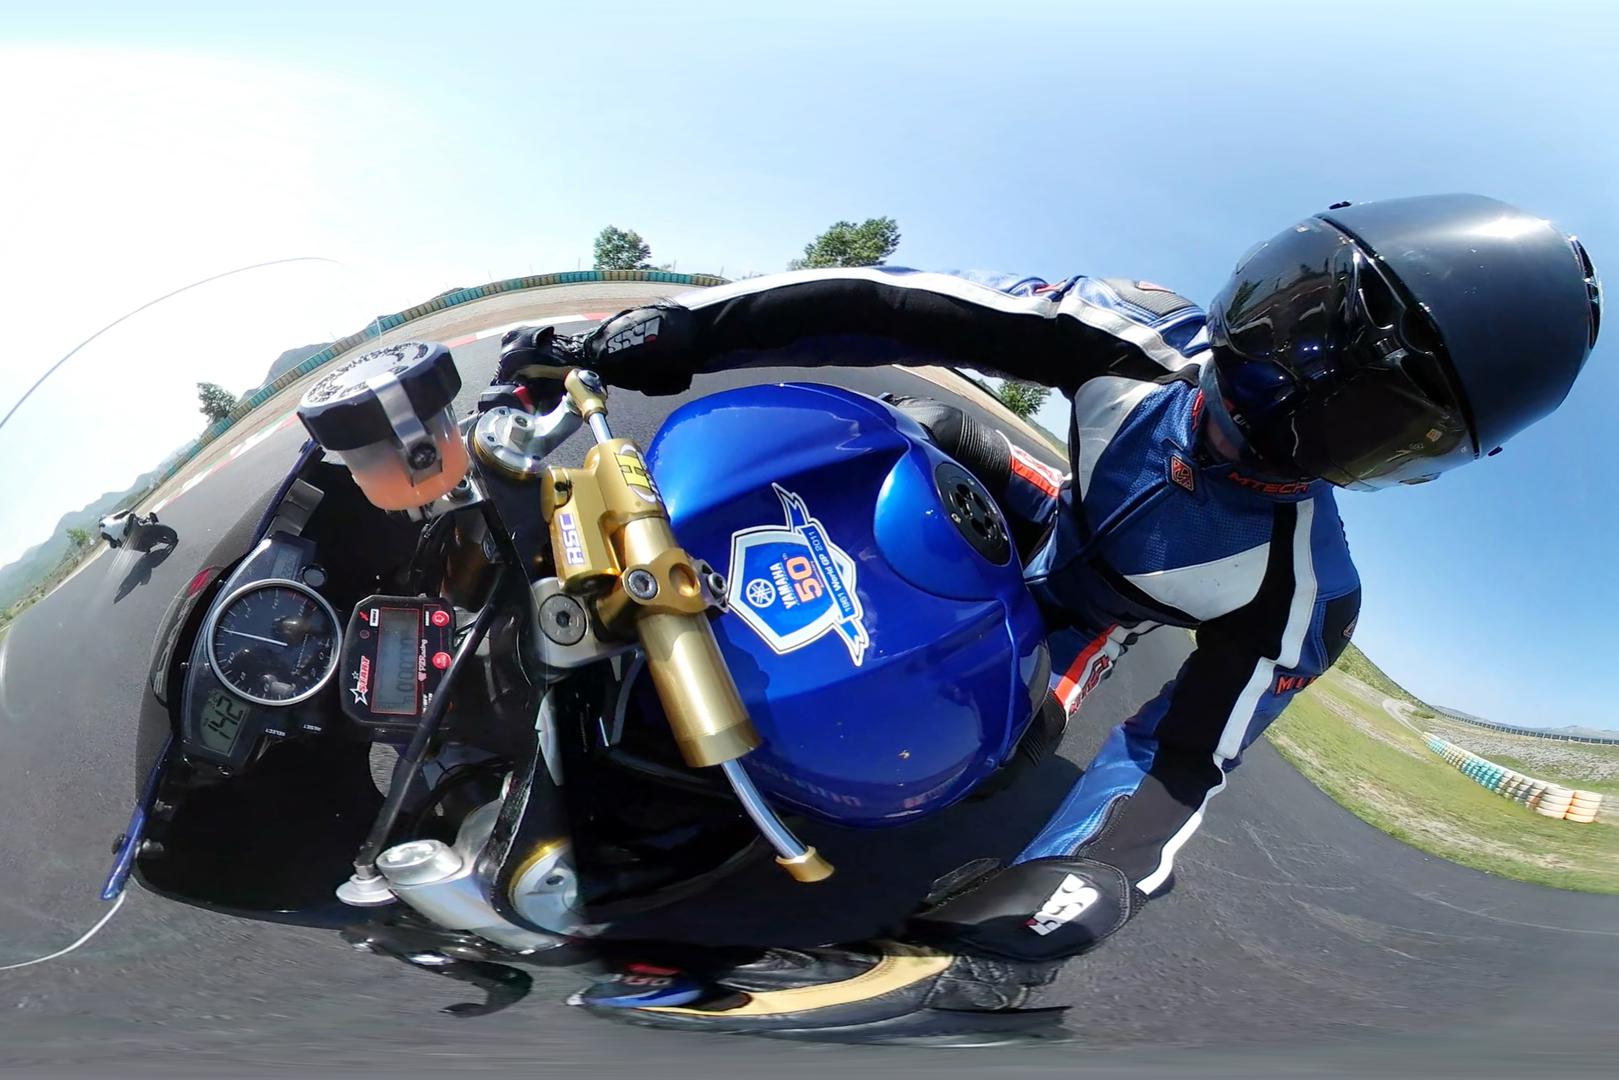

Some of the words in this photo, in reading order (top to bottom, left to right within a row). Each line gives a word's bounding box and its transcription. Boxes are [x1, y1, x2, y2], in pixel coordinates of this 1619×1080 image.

[808, 531, 823, 552] 2011
[818, 552, 829, 566] GP
[769, 562, 797, 609] YAMAHA
[786, 556, 822, 602] 50
[825, 565, 842, 592] World
[207, 694, 243, 739] 142
